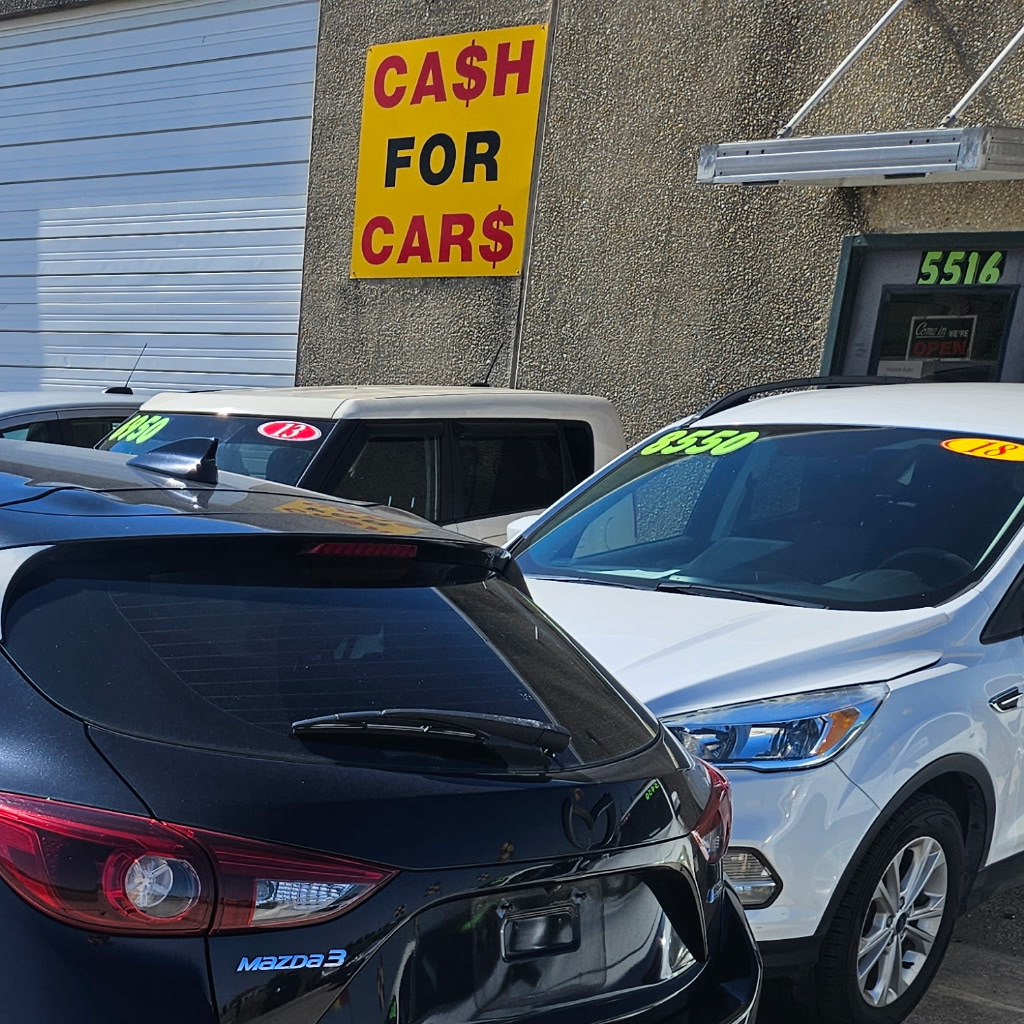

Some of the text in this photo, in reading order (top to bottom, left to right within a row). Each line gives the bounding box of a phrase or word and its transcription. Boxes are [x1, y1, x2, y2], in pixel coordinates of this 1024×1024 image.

[373, 39, 535, 109] CA$H
[384, 130, 501, 188] FOR
[361, 204, 514, 269] CAR$
[917, 251, 1002, 285] 5516
[912, 341, 968, 356] OPEN
[270, 423, 307, 438] 13
[640, 429, 760, 456] 8550
[964, 441, 1019, 457] 18
